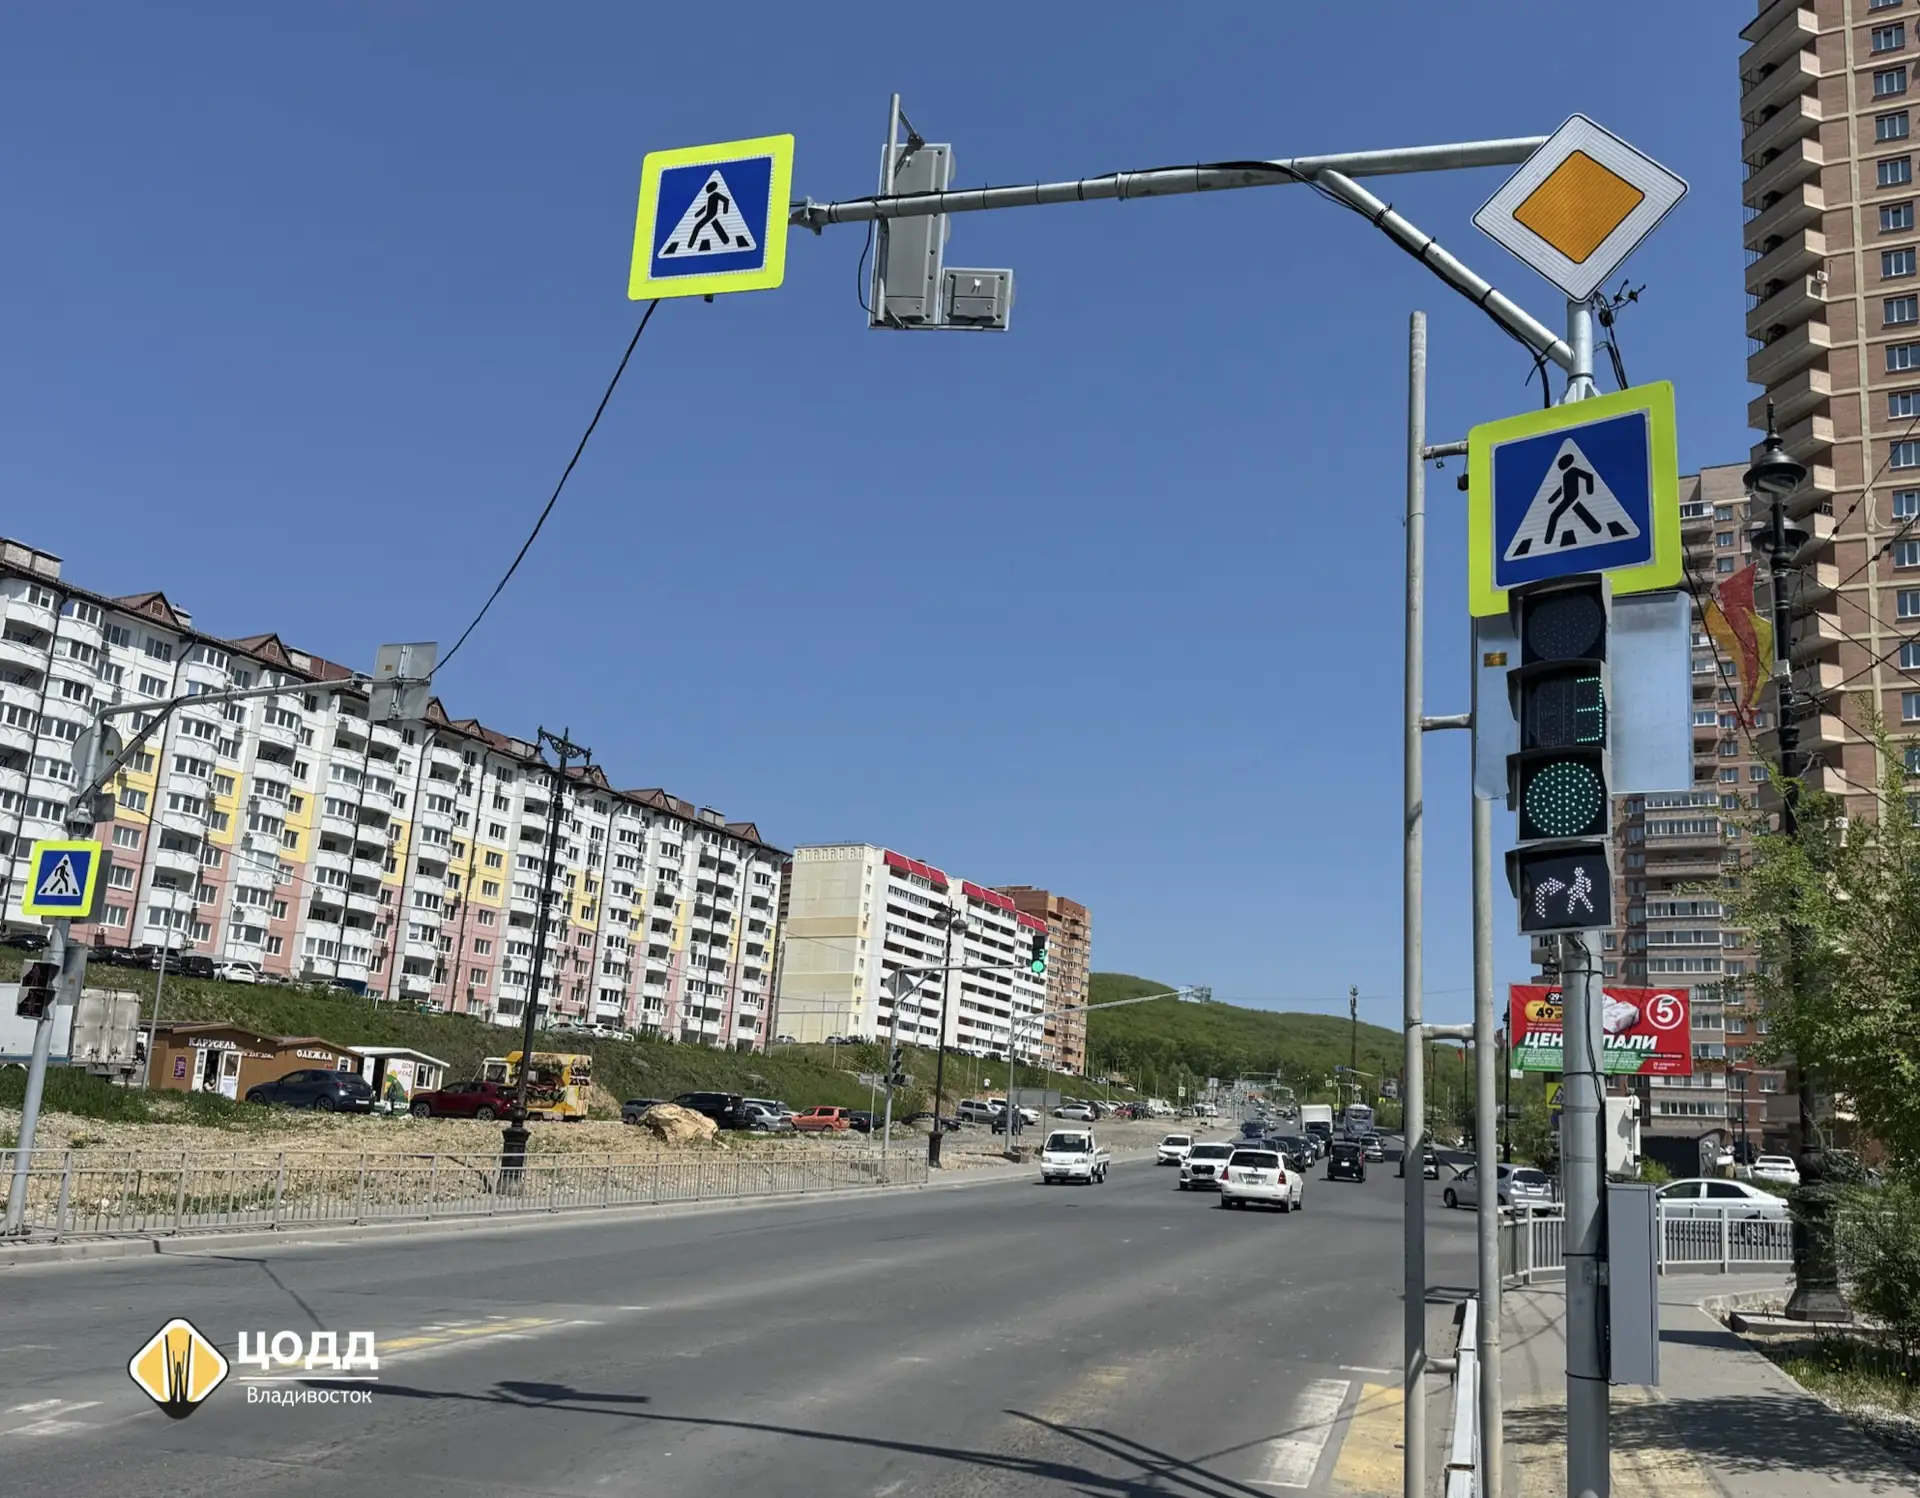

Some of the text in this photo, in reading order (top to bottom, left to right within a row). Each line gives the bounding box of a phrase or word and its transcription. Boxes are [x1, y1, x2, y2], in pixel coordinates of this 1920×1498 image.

[1576, 676, 1603, 743] 3
[1536, 1007, 1554, 1019] 49
[1656, 996, 1674, 1023] 5
[188, 1037, 237, 1050] КАРУСЕЛЬ
[1524, 1031, 1658, 1050] ЦЕН ПАЛИ
[296, 1049, 333, 1061] ОДЕЖДА
